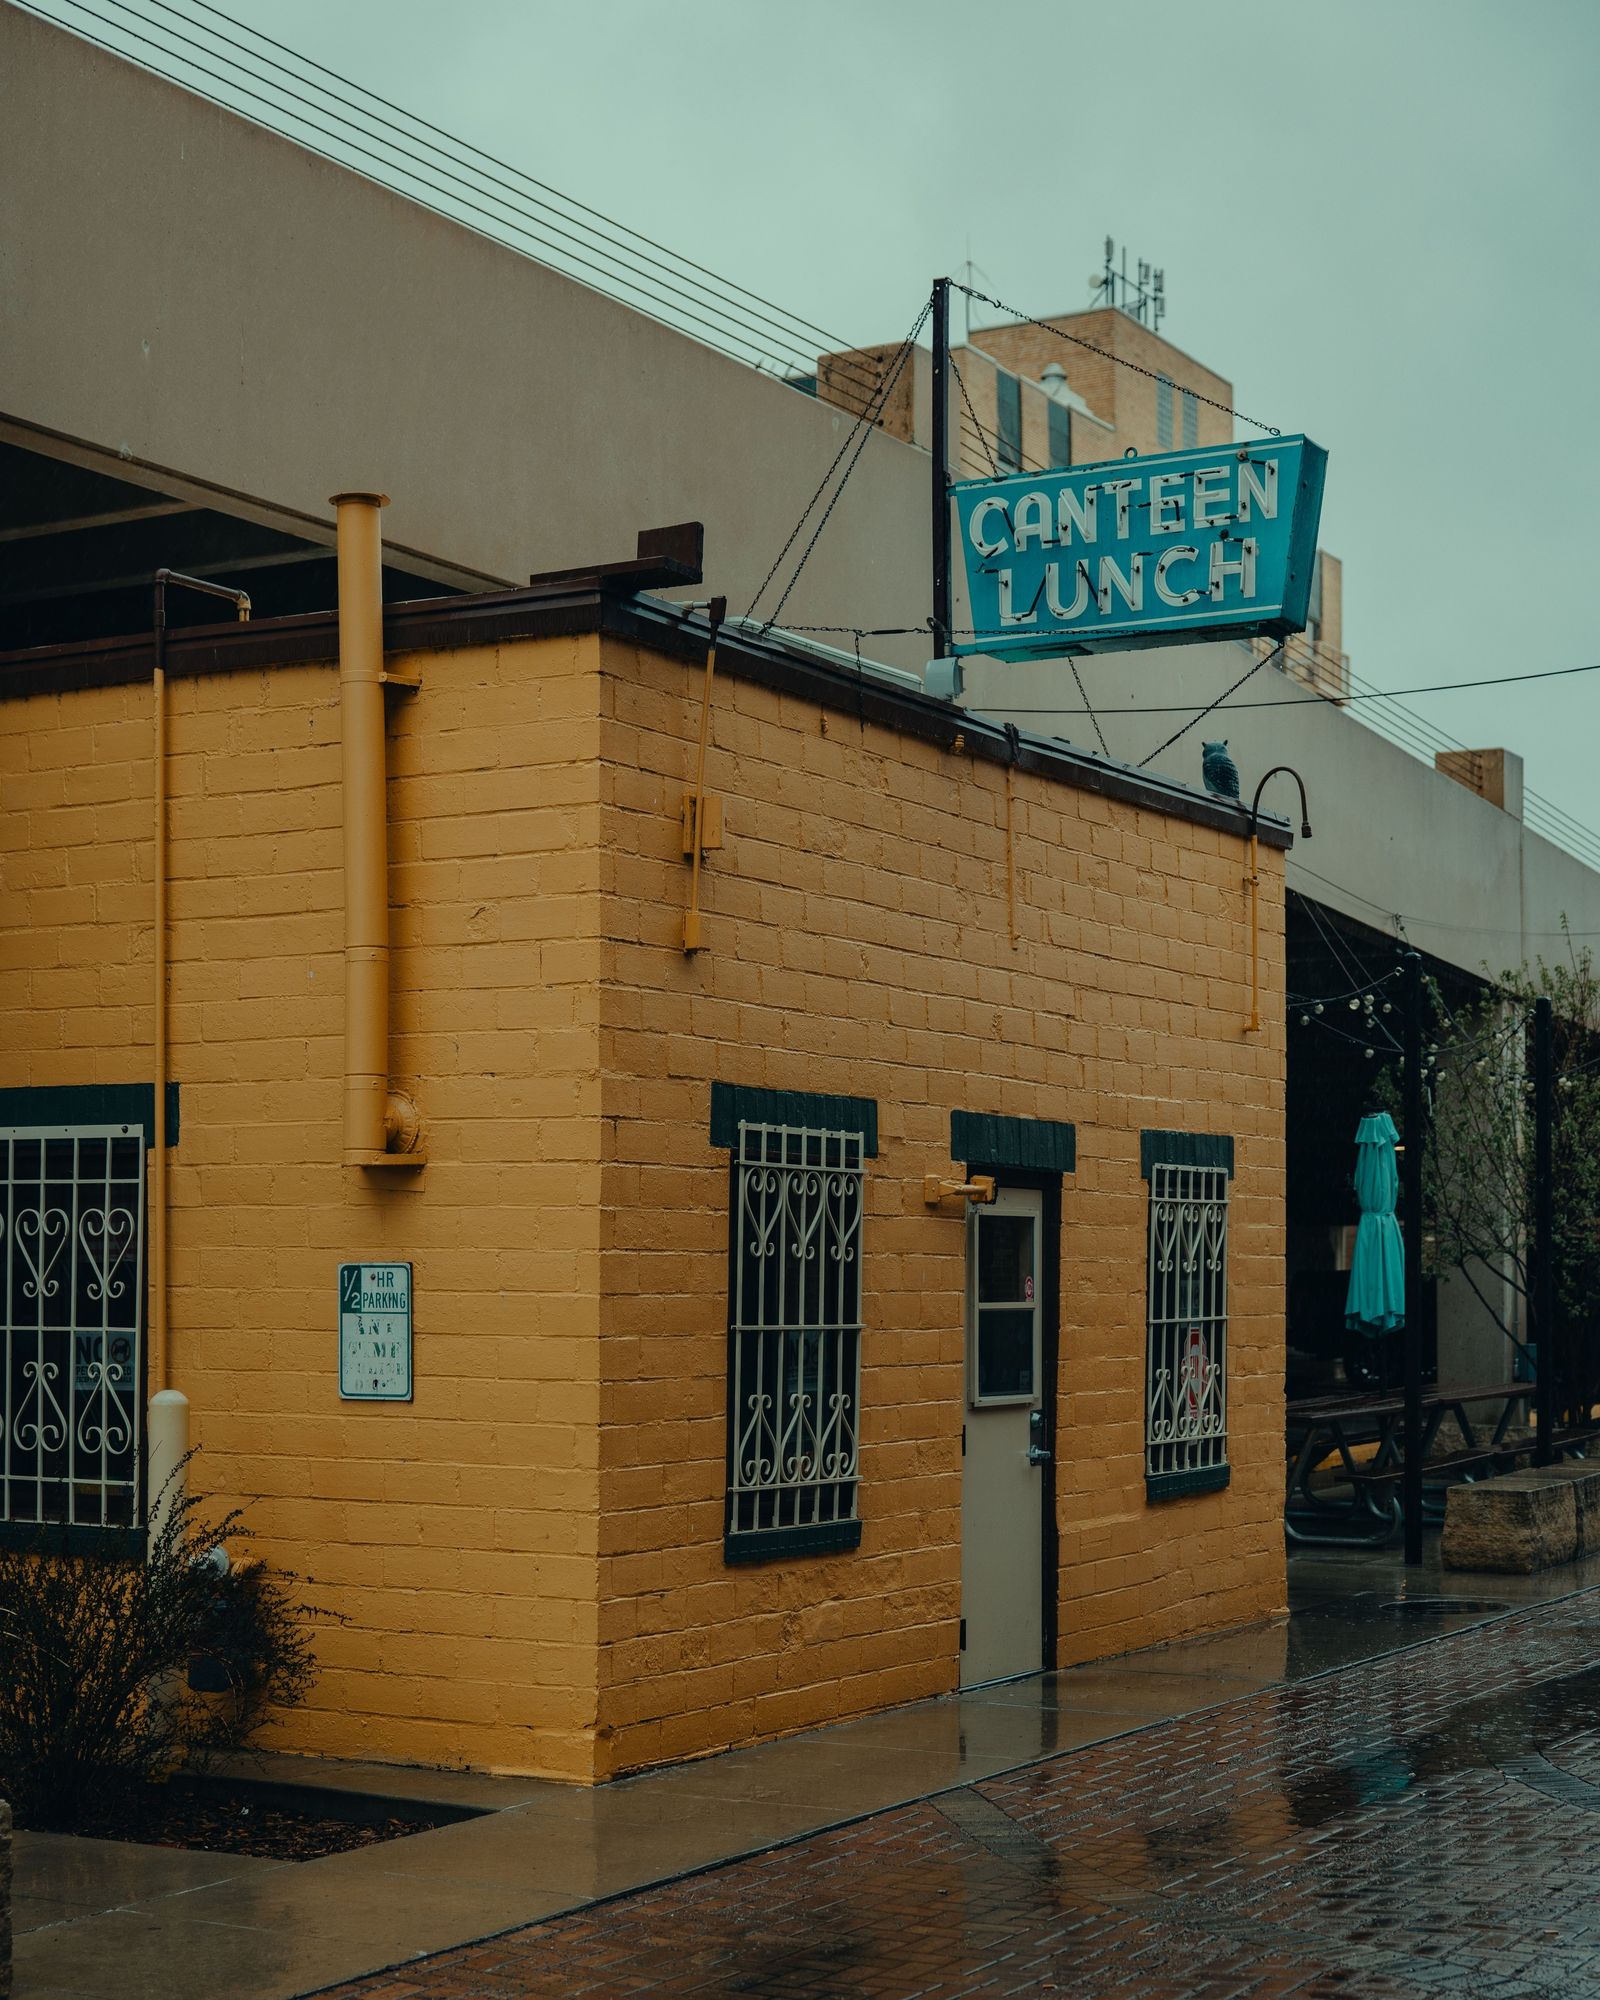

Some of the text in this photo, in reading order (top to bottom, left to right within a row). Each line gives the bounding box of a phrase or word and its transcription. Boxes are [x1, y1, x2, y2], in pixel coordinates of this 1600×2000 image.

[968, 458, 1279, 558] CANTEEN
[998, 537, 1257, 627] LUNCH
[362, 1292, 406, 1309] PARKING
[377, 1271, 394, 1288] HR
